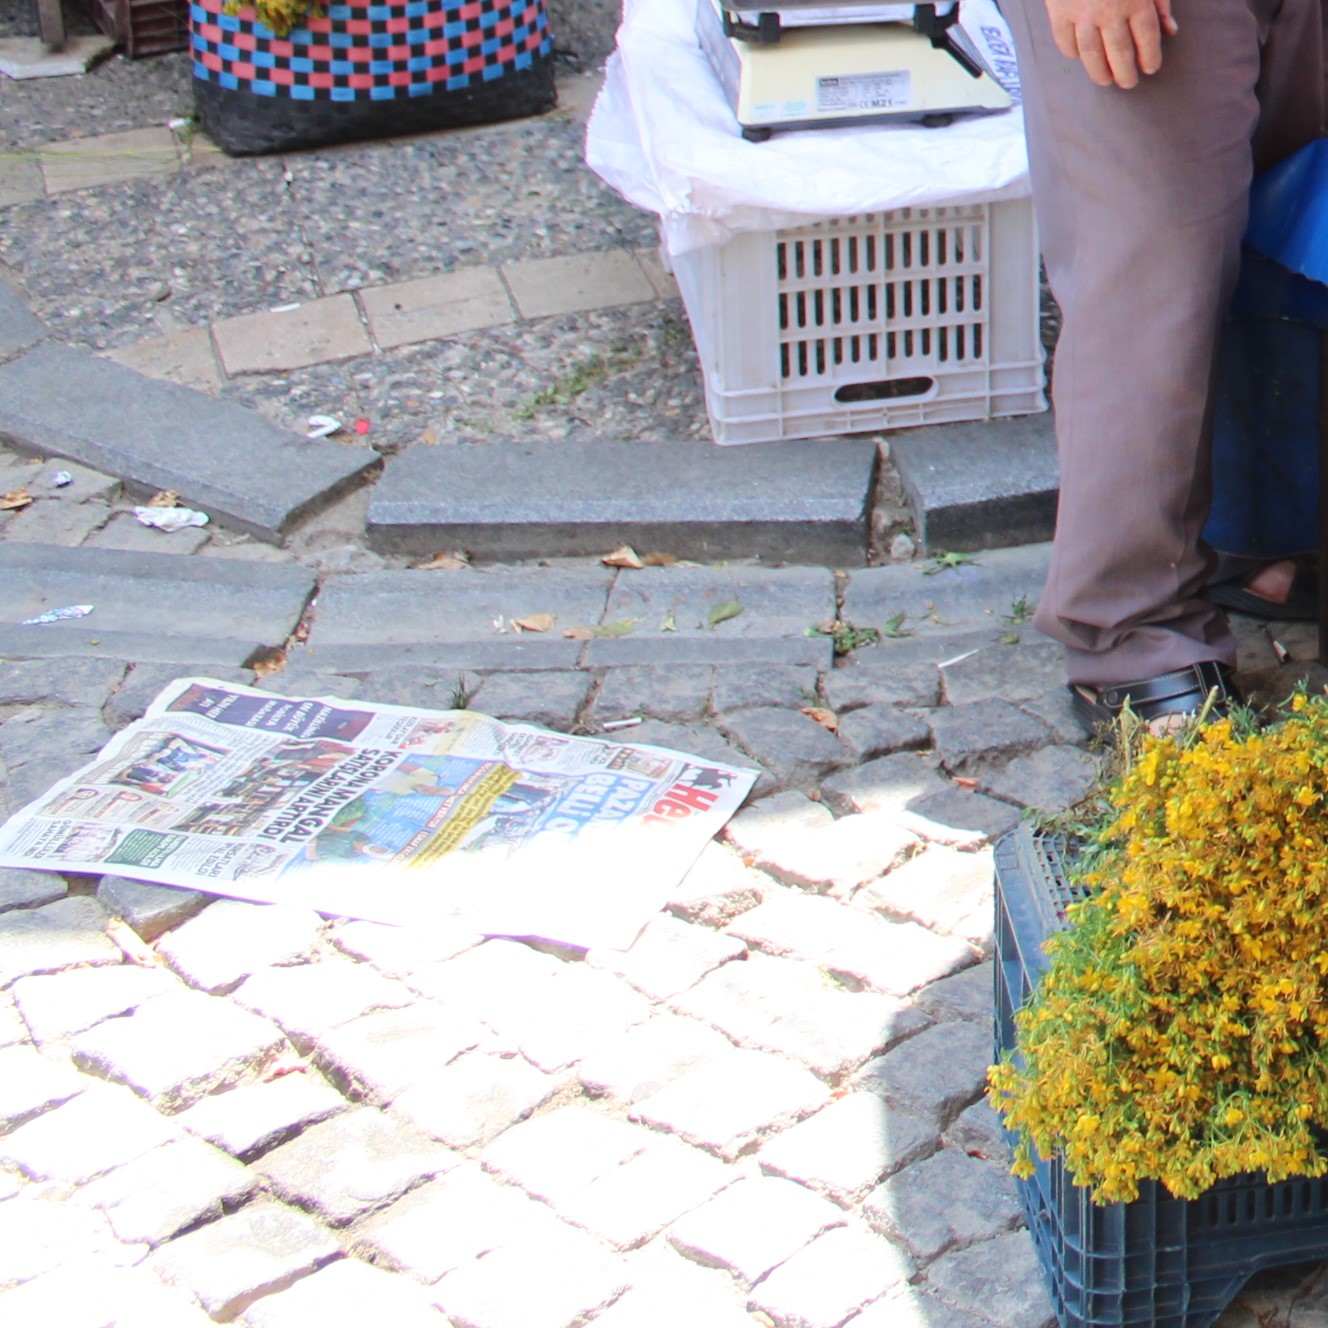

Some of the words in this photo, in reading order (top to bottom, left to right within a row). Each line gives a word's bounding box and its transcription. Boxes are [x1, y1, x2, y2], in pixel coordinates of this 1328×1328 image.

[303, 747, 381, 799] SATIŞLARINI
[343, 749, 403, 788] KORONA
[255, 795, 317, 840] ARTIRDI
[279, 788, 358, 844] MANGAL
